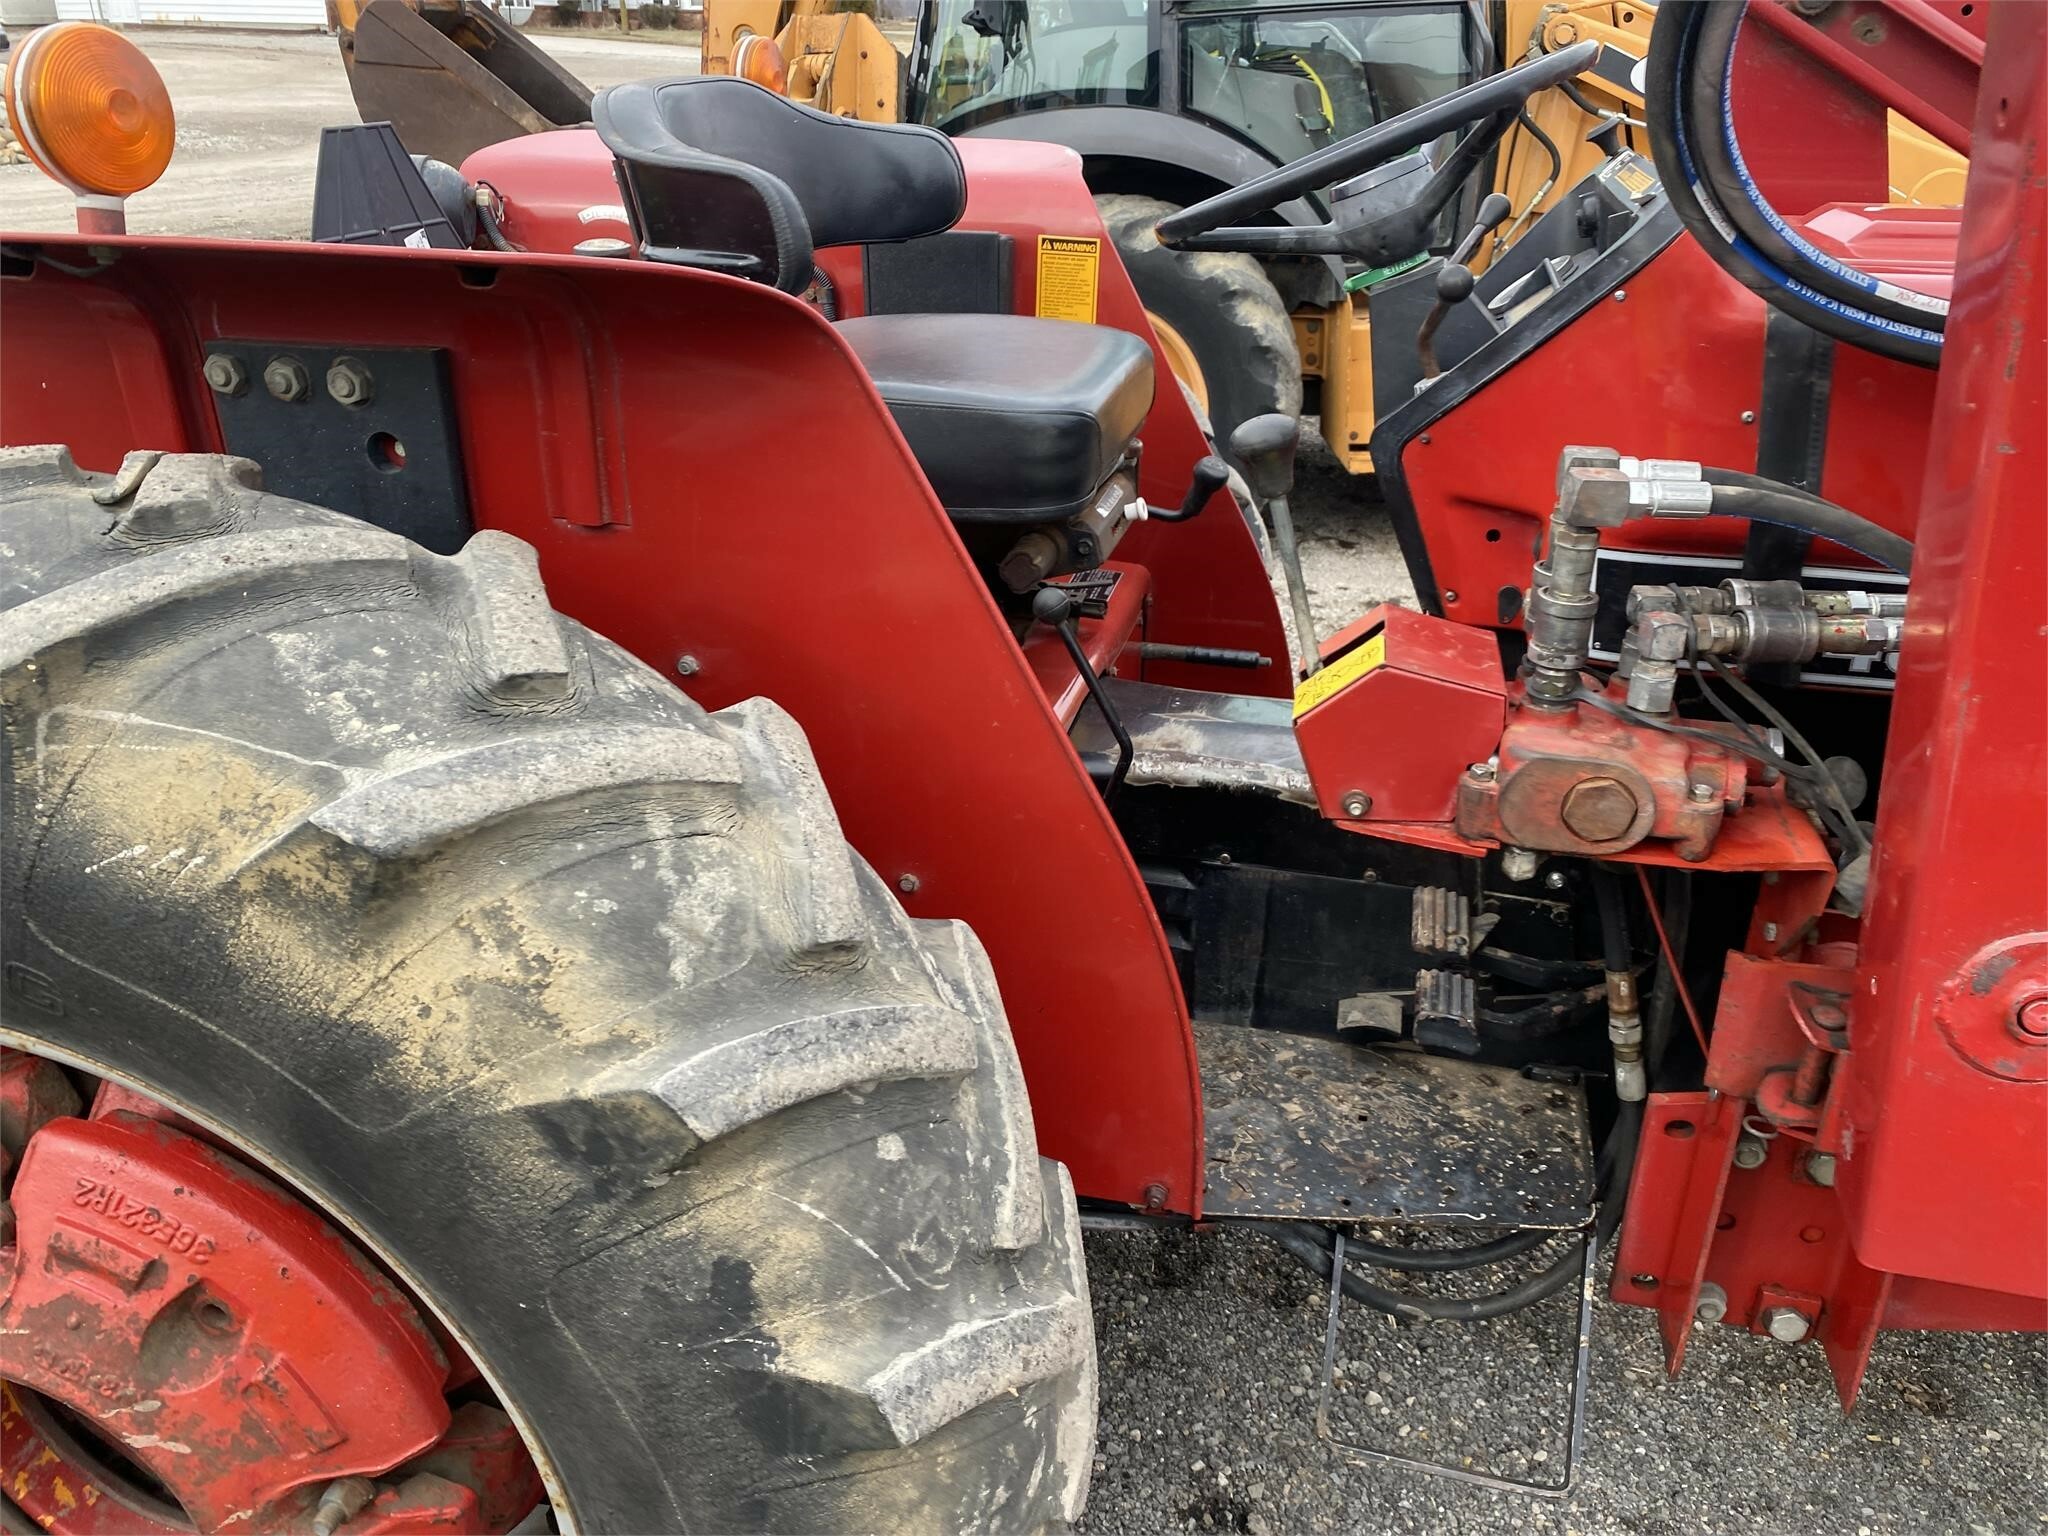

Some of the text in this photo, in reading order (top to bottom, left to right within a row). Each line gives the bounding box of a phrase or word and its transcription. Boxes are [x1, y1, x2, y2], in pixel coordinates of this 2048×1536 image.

[1053, 241, 1096, 252] WARNING
[1839, 303, 1866, 321] MSHA
[1867, 315, 1922, 338] RESISTANT
